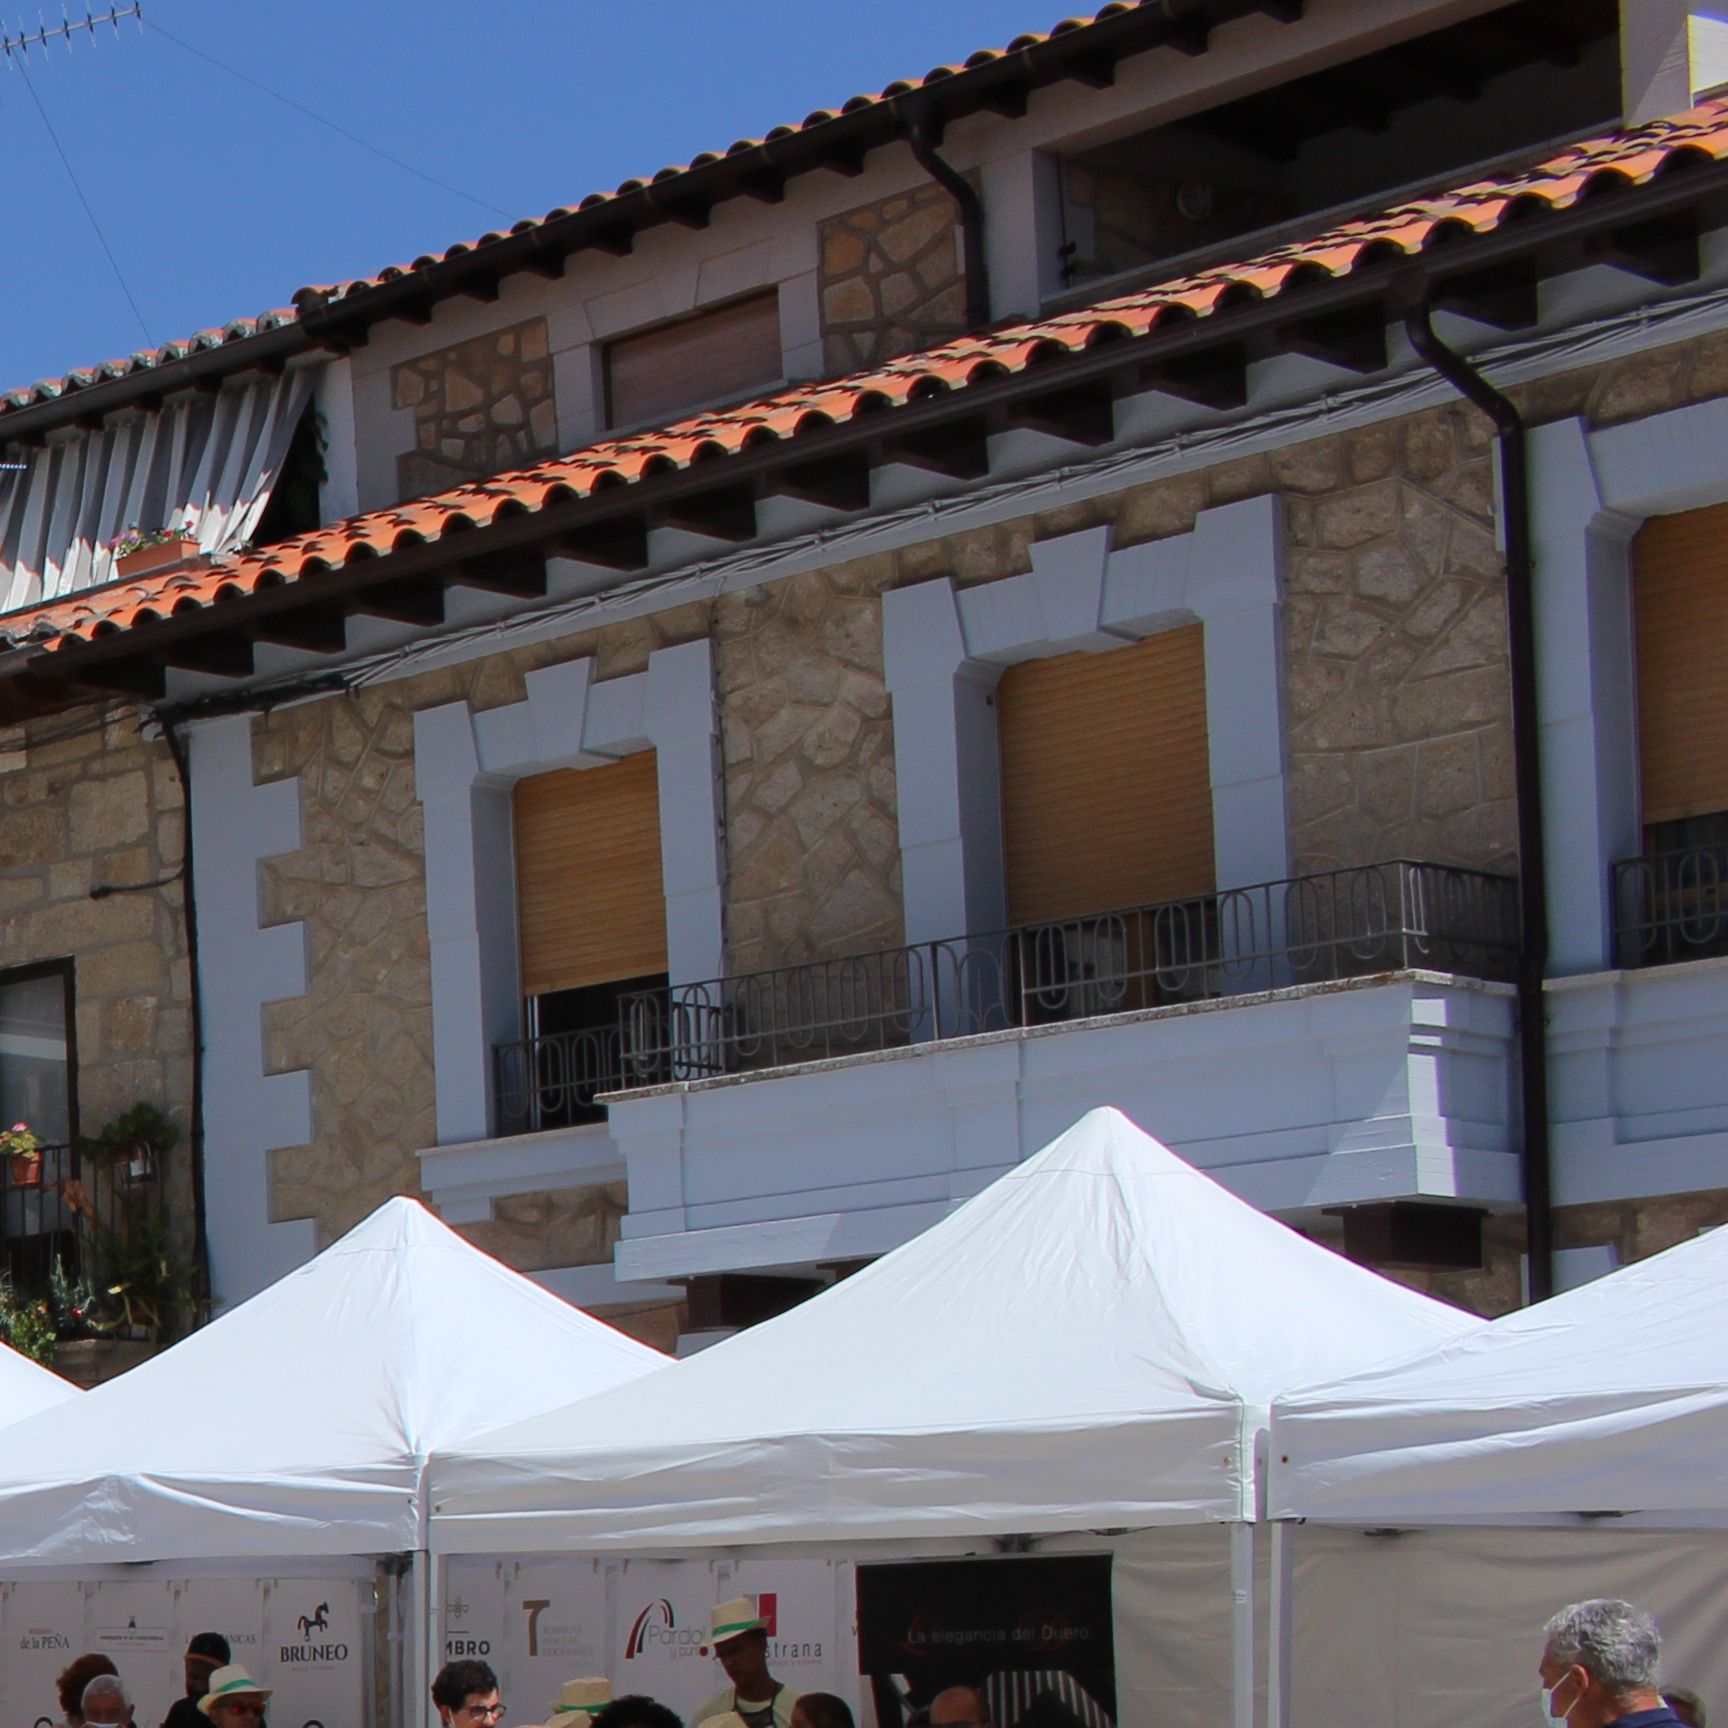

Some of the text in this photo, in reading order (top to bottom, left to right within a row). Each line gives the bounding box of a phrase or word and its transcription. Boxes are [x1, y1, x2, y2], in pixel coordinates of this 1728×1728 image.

[19, 1634, 70, 1650] de la PEÑA
[908, 1625, 1090, 1645] La elegancia del Duero
[280, 1644, 348, 1663] BRUNEO
[765, 1642, 822, 1658] strana
